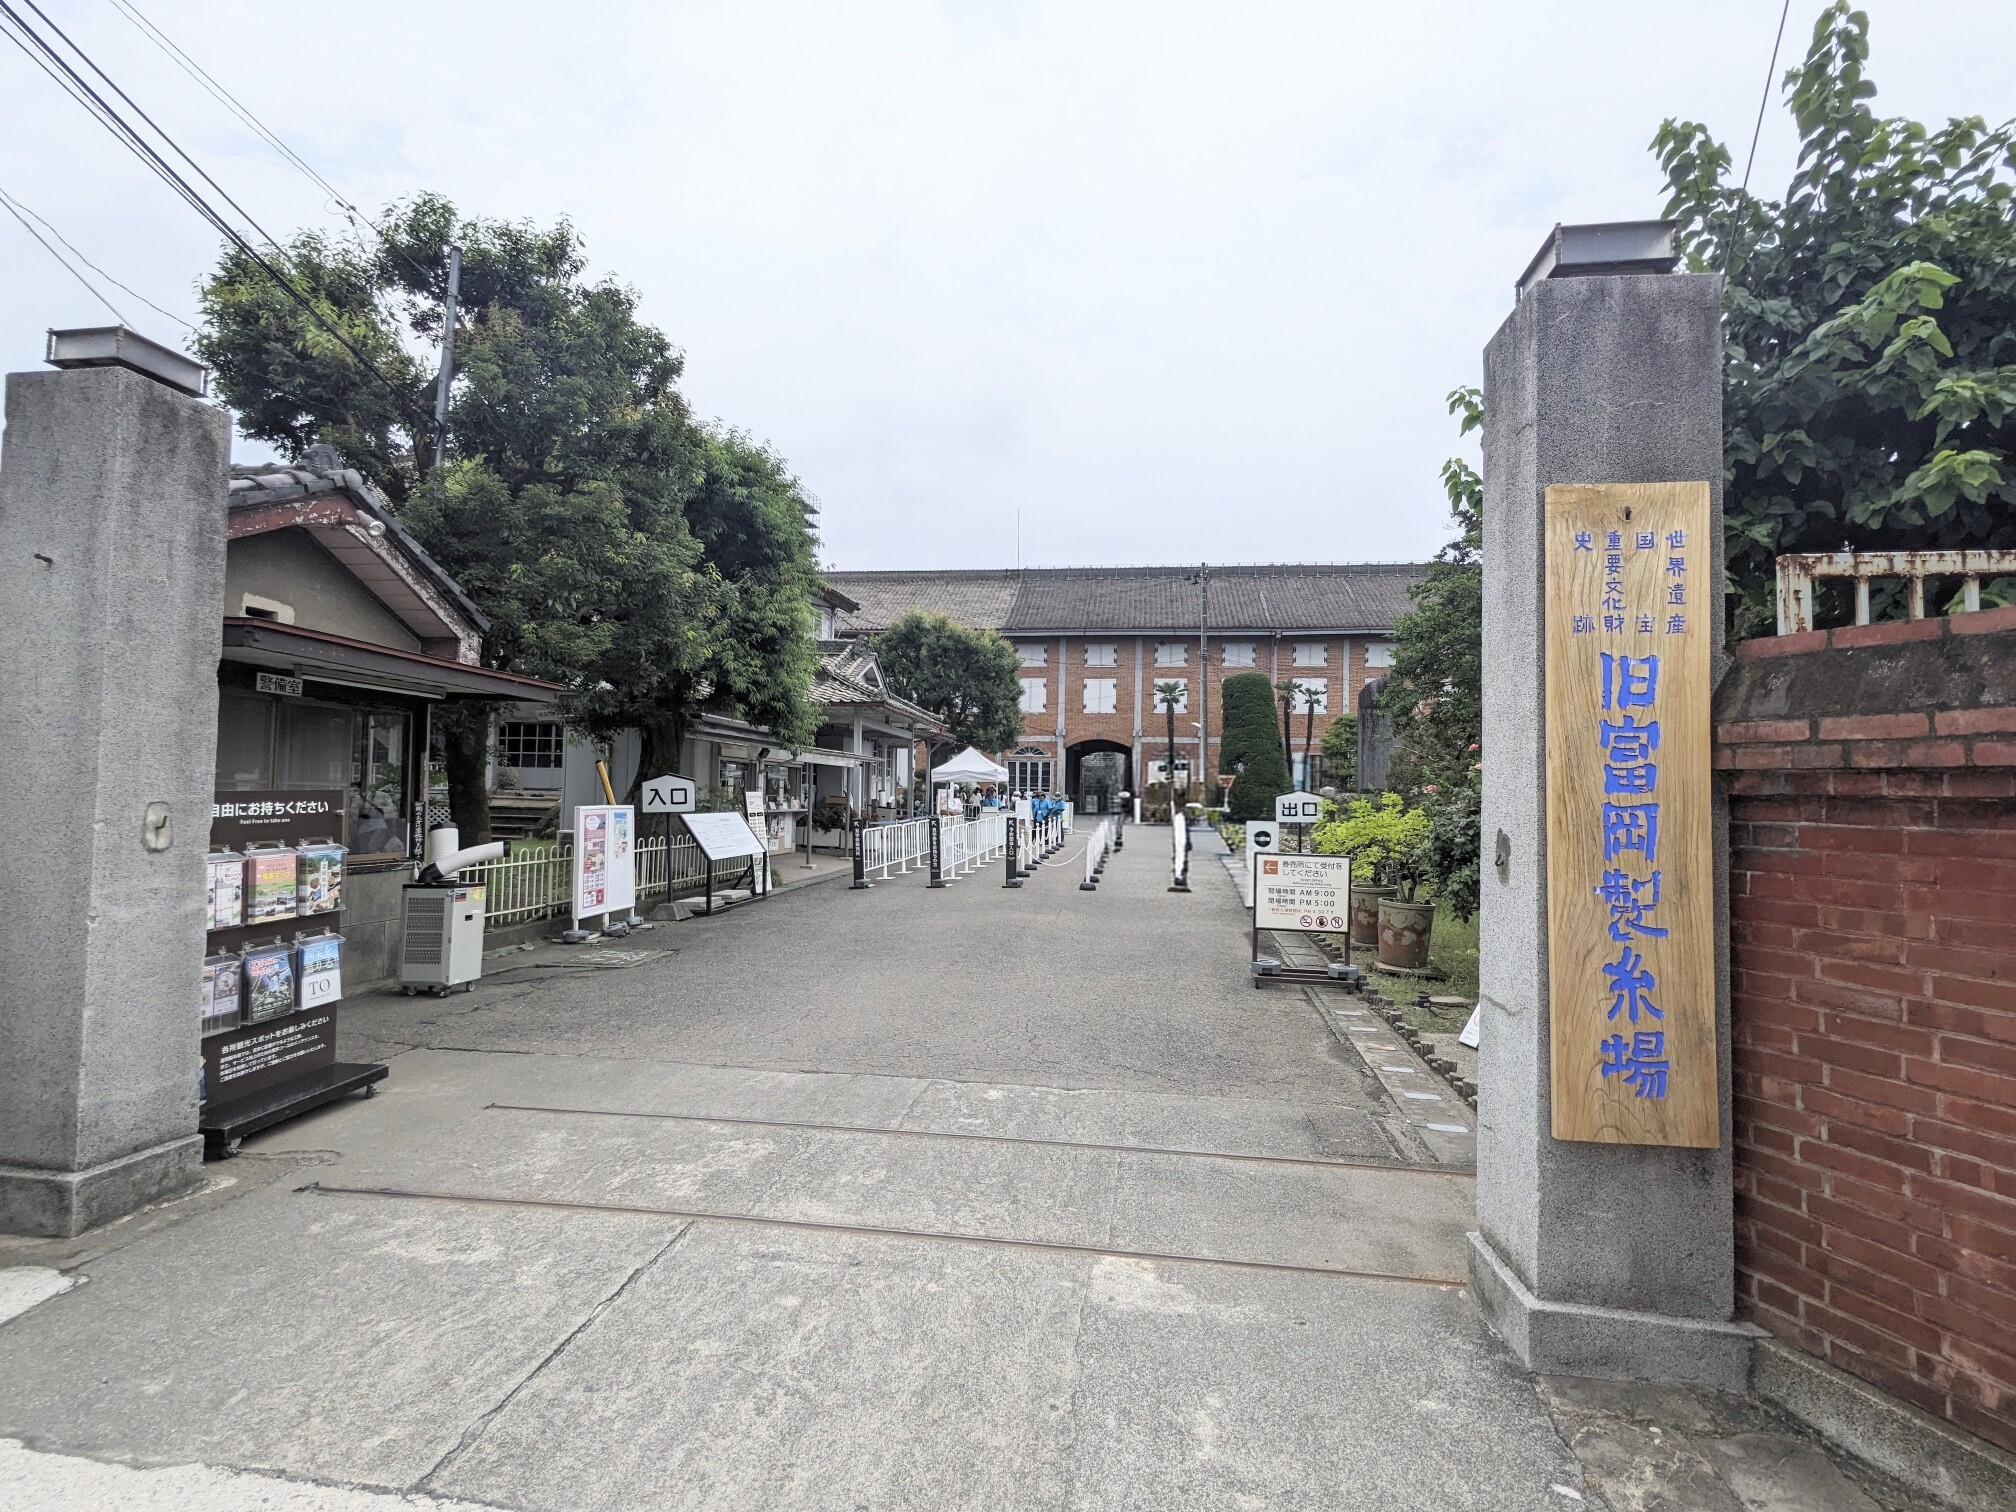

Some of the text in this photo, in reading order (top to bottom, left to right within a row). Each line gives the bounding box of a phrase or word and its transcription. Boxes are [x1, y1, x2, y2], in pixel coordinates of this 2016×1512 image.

[1572, 530, 1596, 634] 史跡
[1602, 530, 1628, 635] 重要文化財
[1634, 530, 1657, 634] 国宝
[1664, 529, 1689, 636] 世界遺産
[260, 674, 301, 695] 警備室
[647, 787, 688, 806] 入口
[212, 800, 329, 818] 自由にお持ちください
[1281, 802, 1318, 817] 出口
[1282, 860, 1343, 871] 券売所にて受付を
[1282, 869, 1328, 878] してください
[1592, 651, 1671, 1100] 旧富岡製糸場
[1268, 888, 1296, 896] 開場時間
[1268, 897, 1296, 906] 閉場時間
[1314, 899, 1335, 907] 5:00
